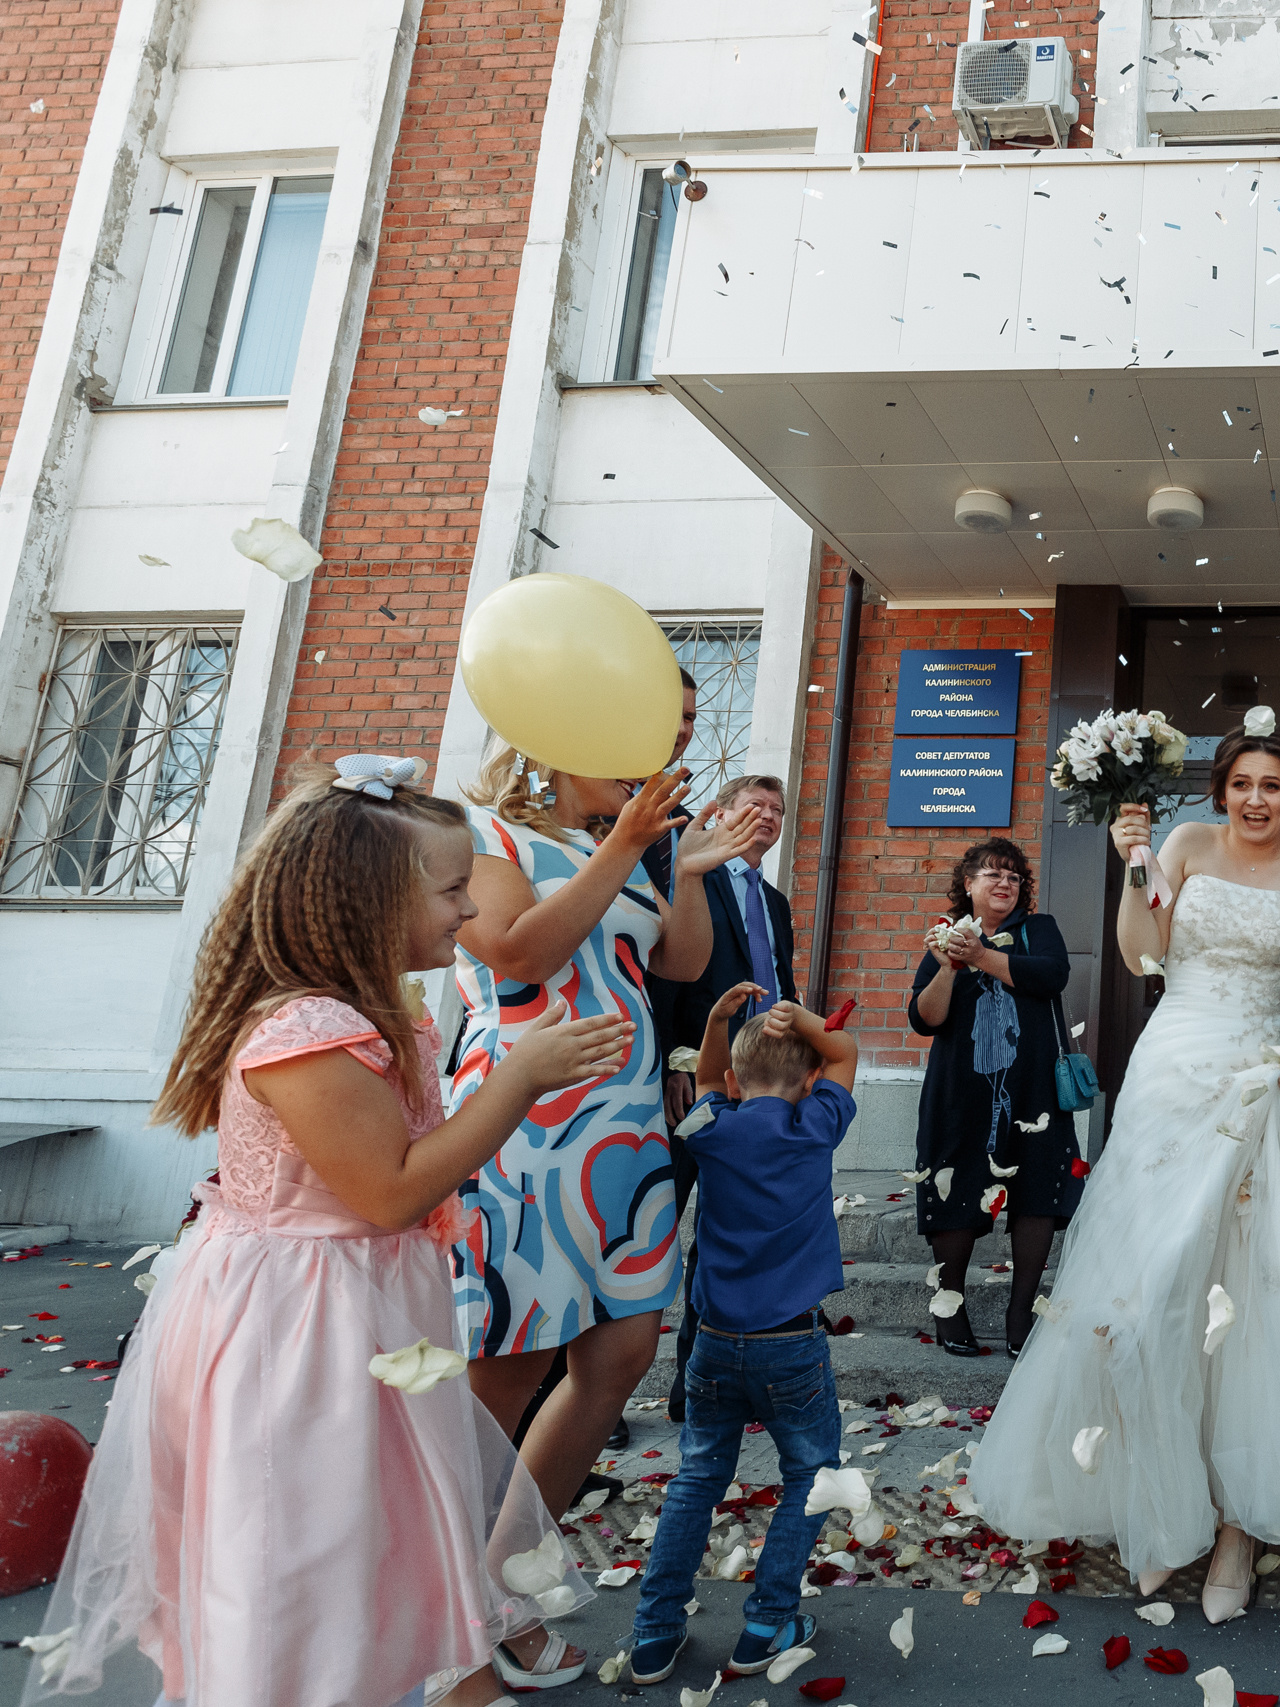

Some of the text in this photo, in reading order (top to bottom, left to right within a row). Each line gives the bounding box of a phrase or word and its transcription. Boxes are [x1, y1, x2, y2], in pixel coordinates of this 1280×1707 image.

[922, 663, 996, 672] АДМИНИСТРАЦИЯ
[925, 678, 992, 687] КАЛИНИНСКОГО
[939, 692, 974, 702] РАЙОНА
[910, 709, 1000, 718] ГОРОДА ЧЕЛЯБИНСКА
[915, 751, 991, 761] СОВЕТ ДЕПУТАТОВ
[900, 767, 1003, 777] КАЛИНИНСКОГО РАЙОНА
[933, 787, 966, 797] ГОРОДА
[920, 804, 976, 813] ЧЕЛЯБИНСКА
